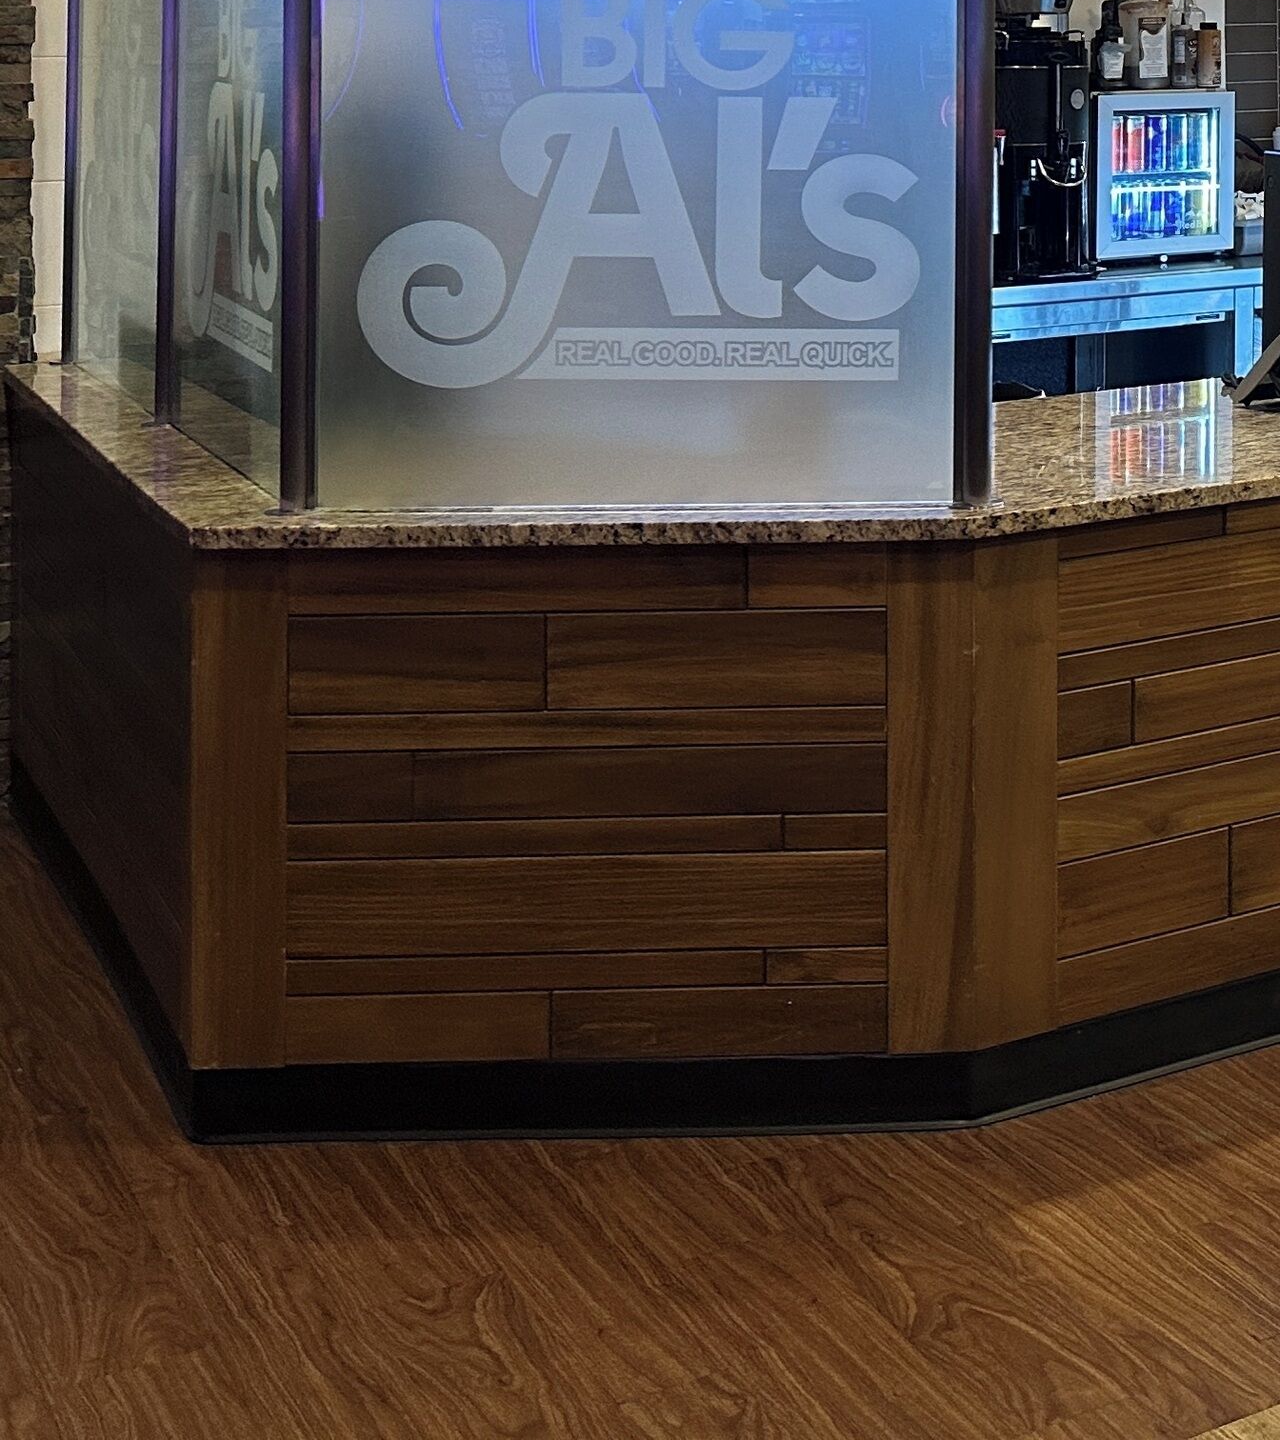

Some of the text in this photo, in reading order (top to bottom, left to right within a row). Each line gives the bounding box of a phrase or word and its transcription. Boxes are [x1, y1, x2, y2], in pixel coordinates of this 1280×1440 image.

[357, 93, 921, 389] Al's
[555, 339, 894, 369] REAL GOOD. REAL QUICK.
